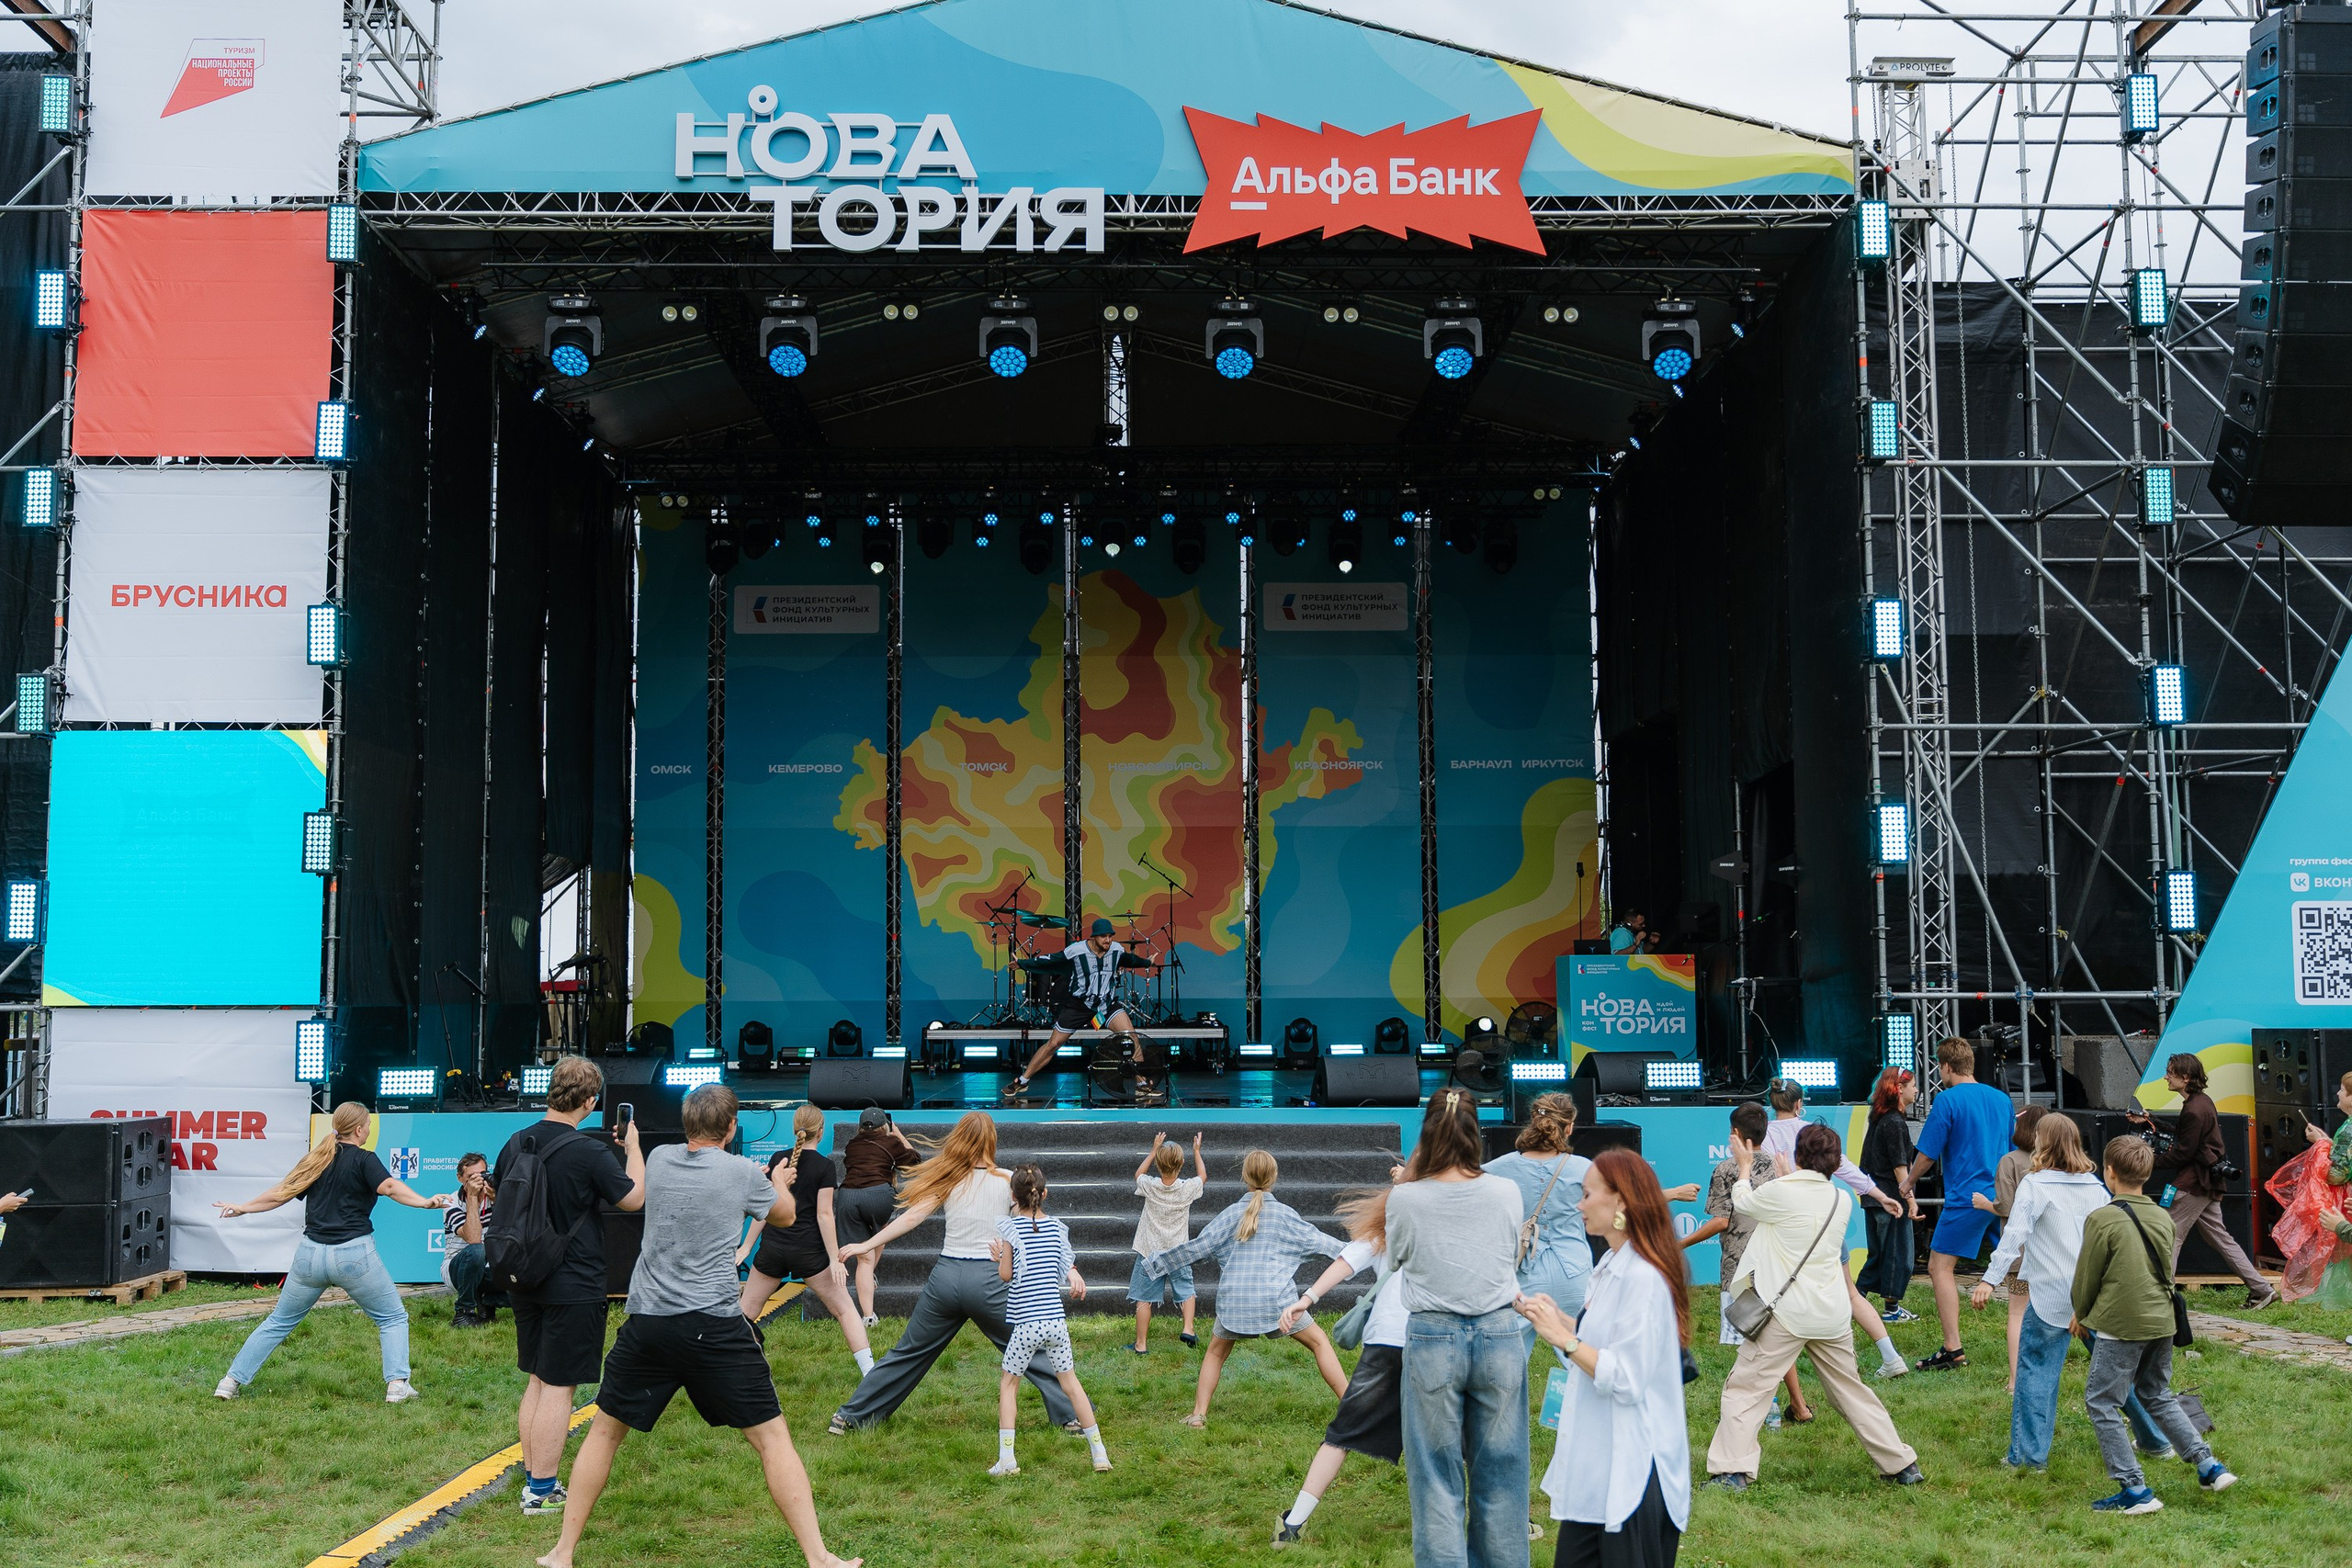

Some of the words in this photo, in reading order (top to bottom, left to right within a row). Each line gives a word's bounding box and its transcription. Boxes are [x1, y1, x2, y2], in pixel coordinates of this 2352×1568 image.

[191, 59, 254, 70] НАЦИОНАЛЬНЫЕ
[1899, 62, 1940, 72] PROLYTE
[217, 68, 254, 78] ПРОЕКТЫ
[223, 77, 253, 87] РОССИИ
[674, 85, 979, 181] НОВА
[1230, 155, 1379, 210] Альфа
[1388, 156, 1501, 197] Банк
[749, 185, 1105, 254] ТОРИЯ
[773, 595, 856, 604] ПРЕЗИДЕНТСКИЙ
[1301, 593, 1384, 602] ПРЕЗИДЕНТСКИЙ
[773, 605, 802, 615] ФОНД
[805, 605, 870, 614] КУЛЬТУРНЫХ
[1301, 603, 1331, 612] ФОНД
[1333, 603, 1398, 611] КУЛЬТУРНЫХ
[772, 615, 833, 624] ИНИЦИАТИВ
[1301, 613, 1362, 622] ИНИЦИАТИВ
[650, 764, 692, 774] ОМСК
[767, 763, 843, 773] КЕМЕРОВО
[958, 761, 1009, 773] ТОМСК
[1108, 761, 1211, 772] НОВОСИБИРСК
[1294, 760, 1384, 771] КРАСНОЯРСК
[1450, 760, 1512, 770] БАРНАУЛ
[1521, 759, 1585, 769] ИРКУТСК
[2290, 858, 2329, 866] группа
[2331, 857, 2352, 866] фес
[2314, 877, 2352, 888] ВКОН
[1580, 992, 1656, 1017] НОВА
[1600, 1016, 1687, 1034] ТОРИЯ
[171, 1142, 219, 1171] AR
